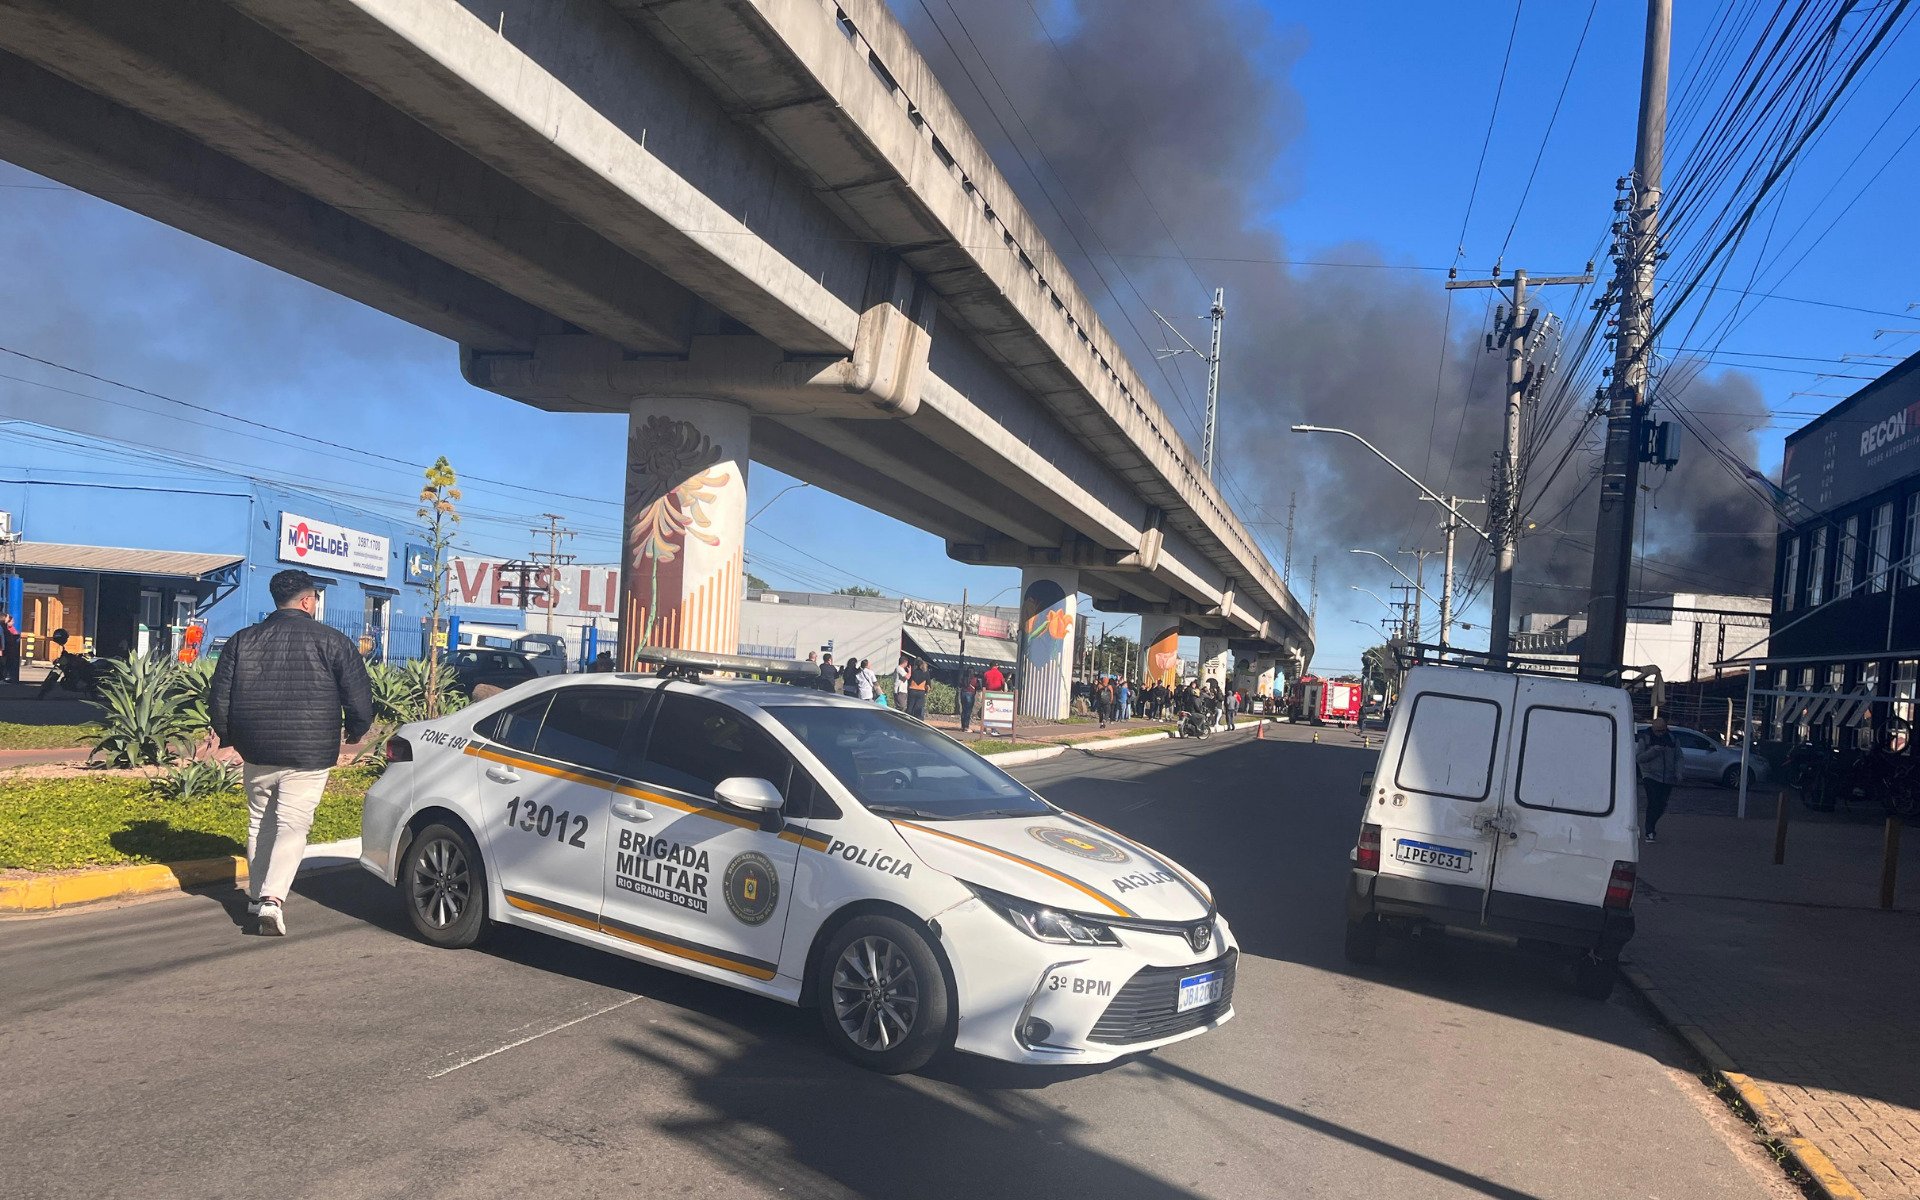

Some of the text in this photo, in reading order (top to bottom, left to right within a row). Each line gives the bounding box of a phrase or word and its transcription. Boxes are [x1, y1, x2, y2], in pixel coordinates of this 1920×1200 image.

[288, 528, 349, 557] MADELIDER
[447, 561, 562, 609] VES
[421, 729, 468, 749] FONE 190
[507, 796, 589, 850] 13012
[619, 828, 710, 873] BRIGADA
[828, 839, 913, 880] POLÍCIA
[1403, 846, 1462, 870] IPE9C31
[616, 851, 708, 898] MILITAR
[617, 877, 706, 911] RIO GRANDE DO SUL
[1072, 977, 1112, 997] BPM
